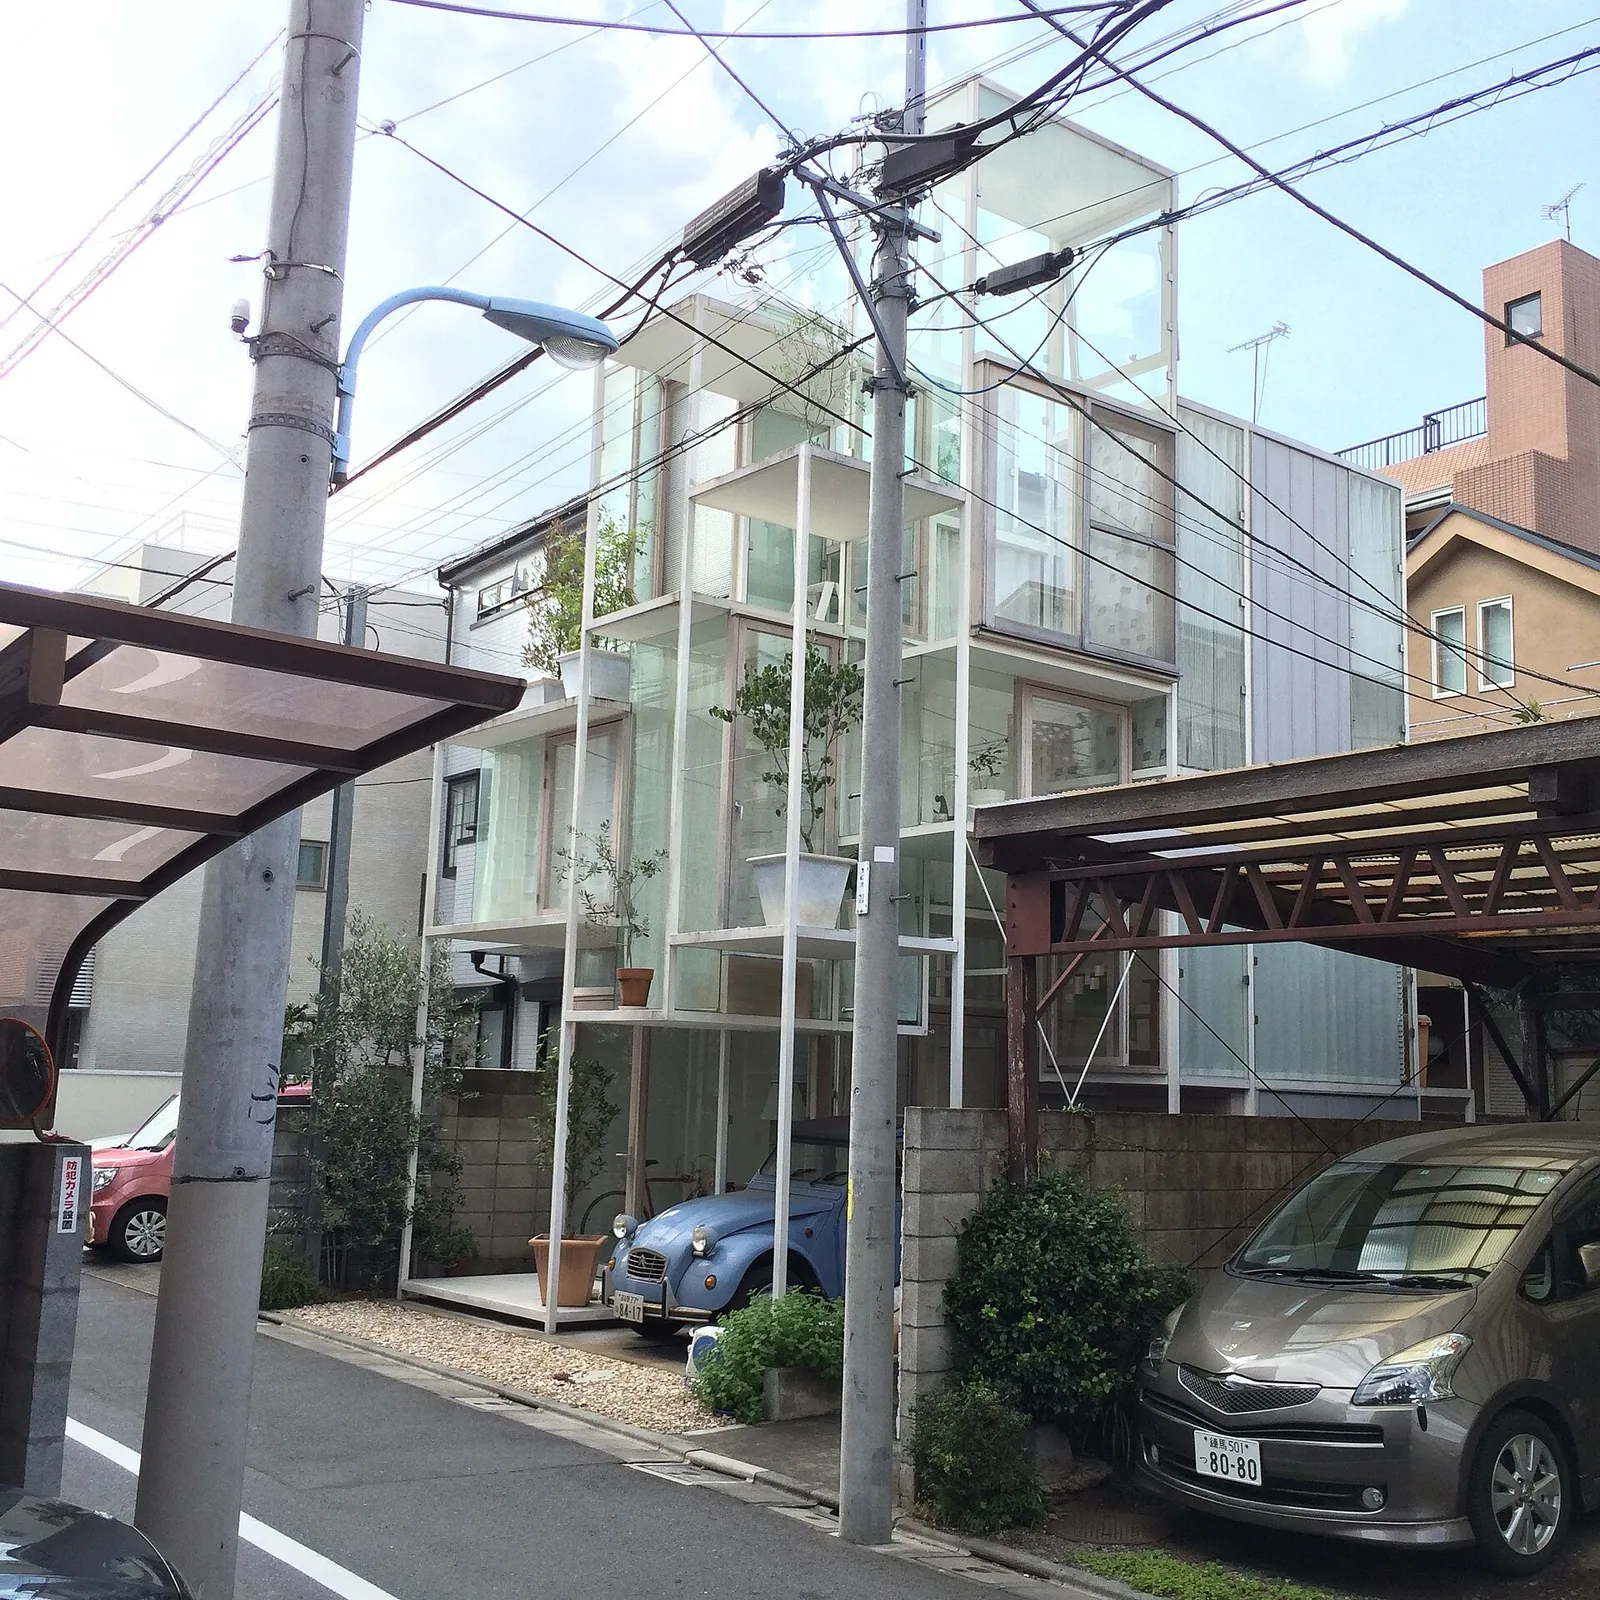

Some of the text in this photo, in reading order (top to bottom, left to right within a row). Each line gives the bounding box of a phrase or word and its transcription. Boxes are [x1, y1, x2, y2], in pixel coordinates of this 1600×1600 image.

[62, 1160, 78, 1230] 防犯カメラ設置
[1210, 1451, 1257, 1481] 80-80
